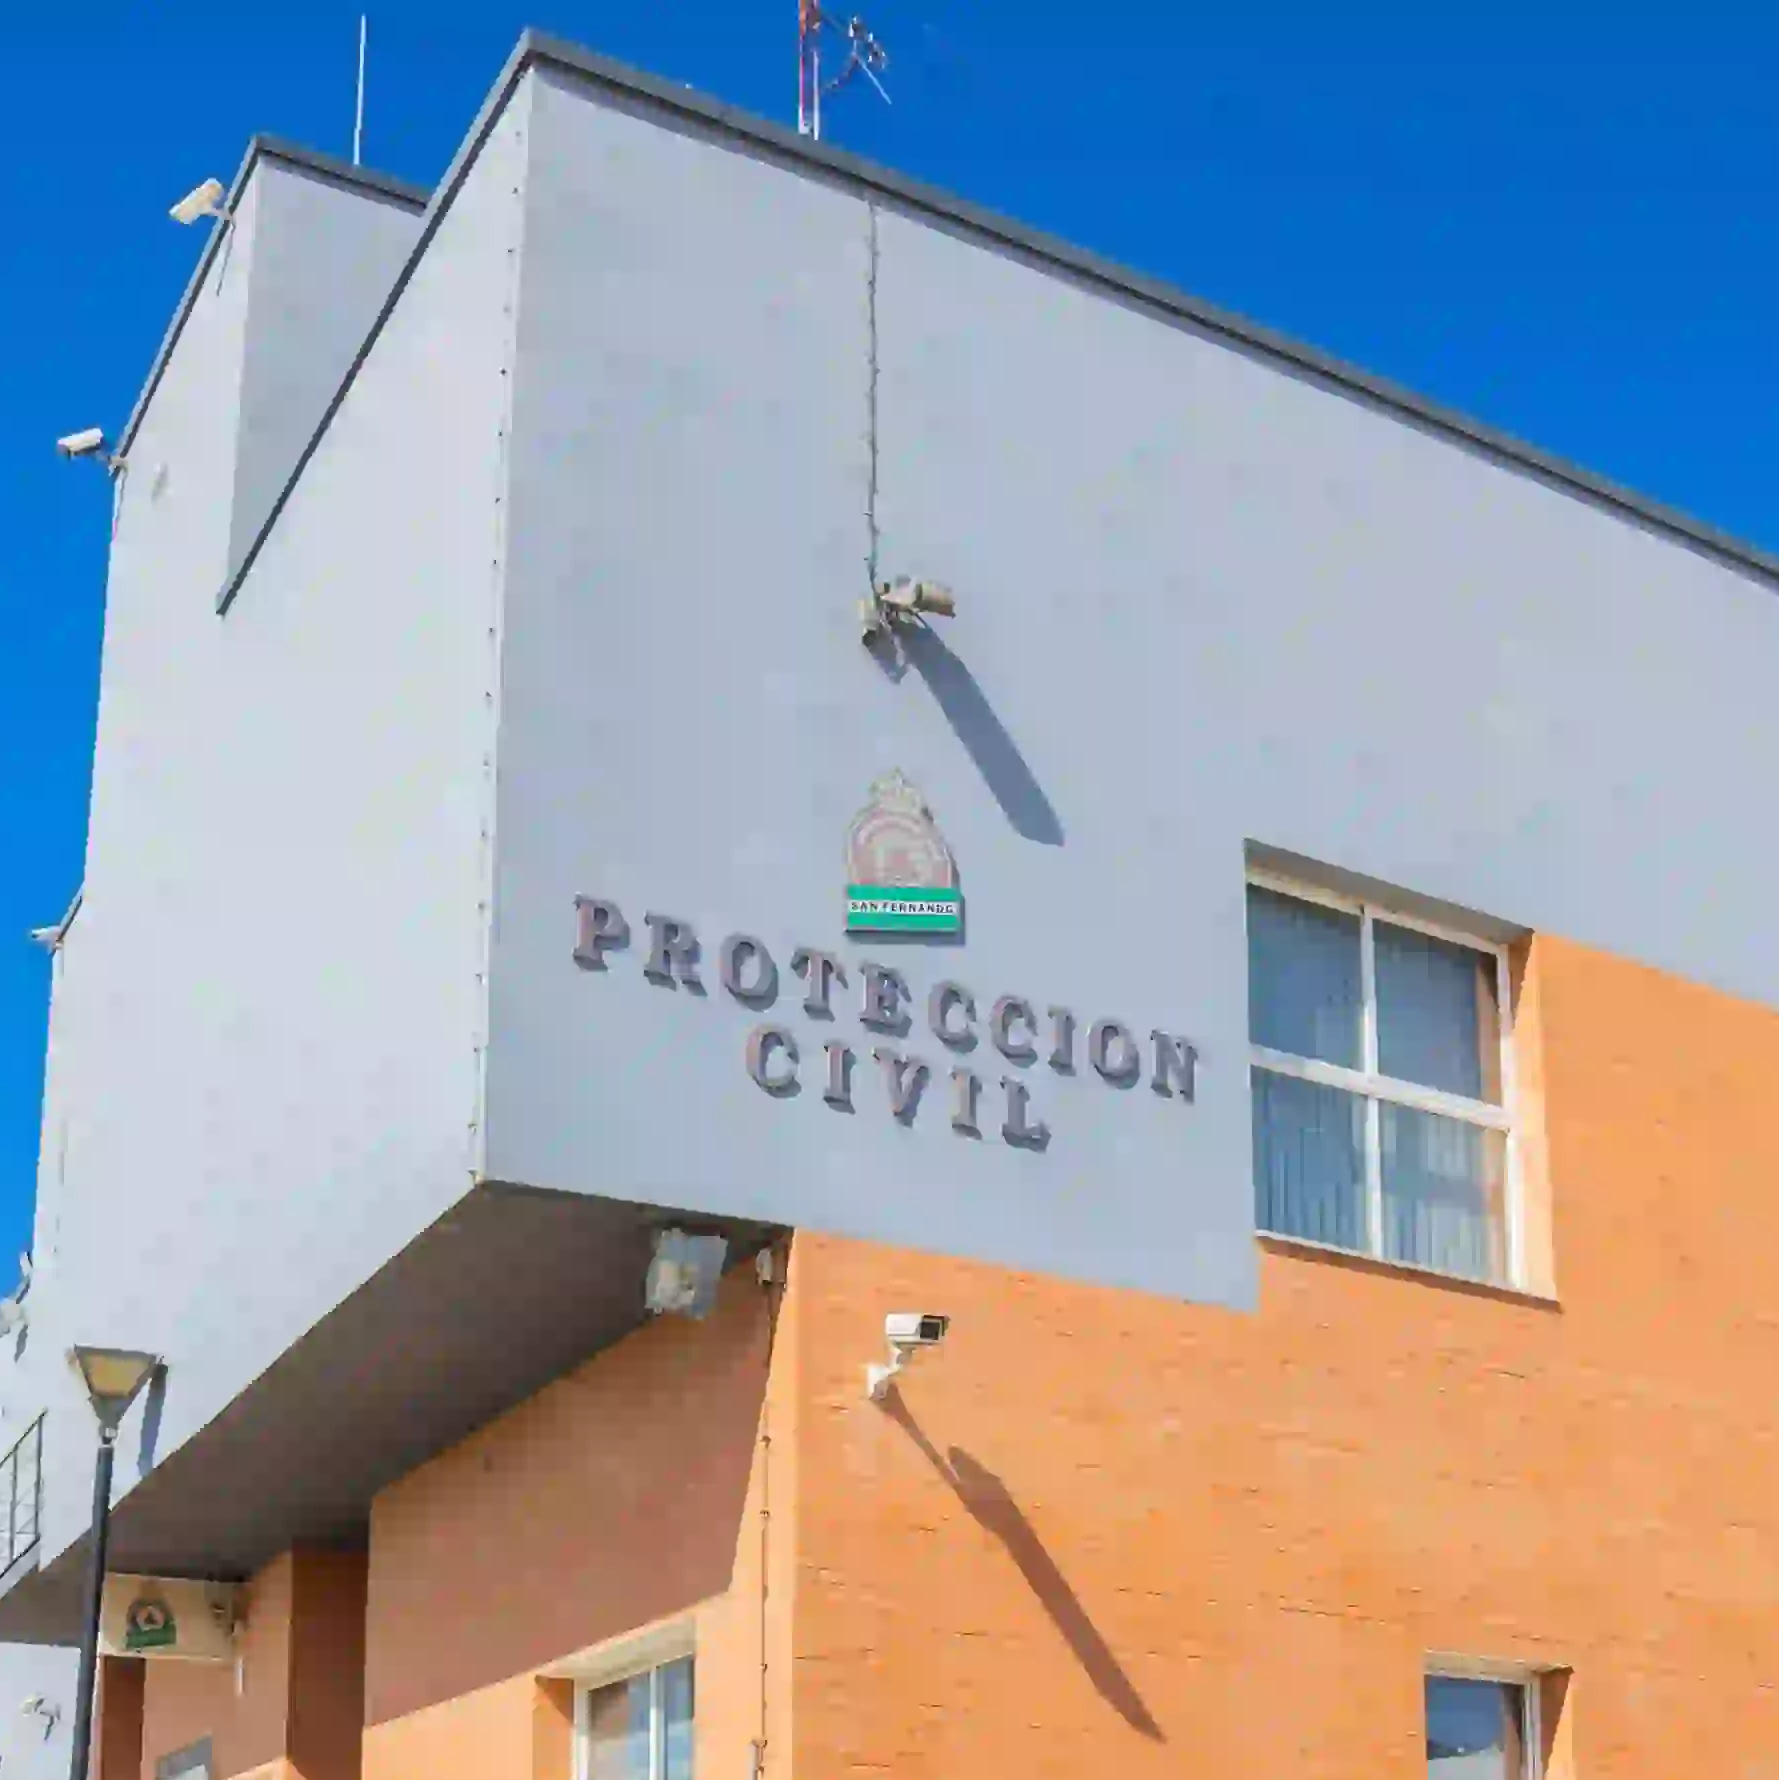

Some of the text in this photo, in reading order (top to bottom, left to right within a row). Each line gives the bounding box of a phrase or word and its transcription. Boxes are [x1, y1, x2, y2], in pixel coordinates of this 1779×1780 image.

[851, 902, 878, 911] SAN
[572, 892, 1199, 1103] PROTECCION
[745, 1022, 1052, 1153] CIVIL
